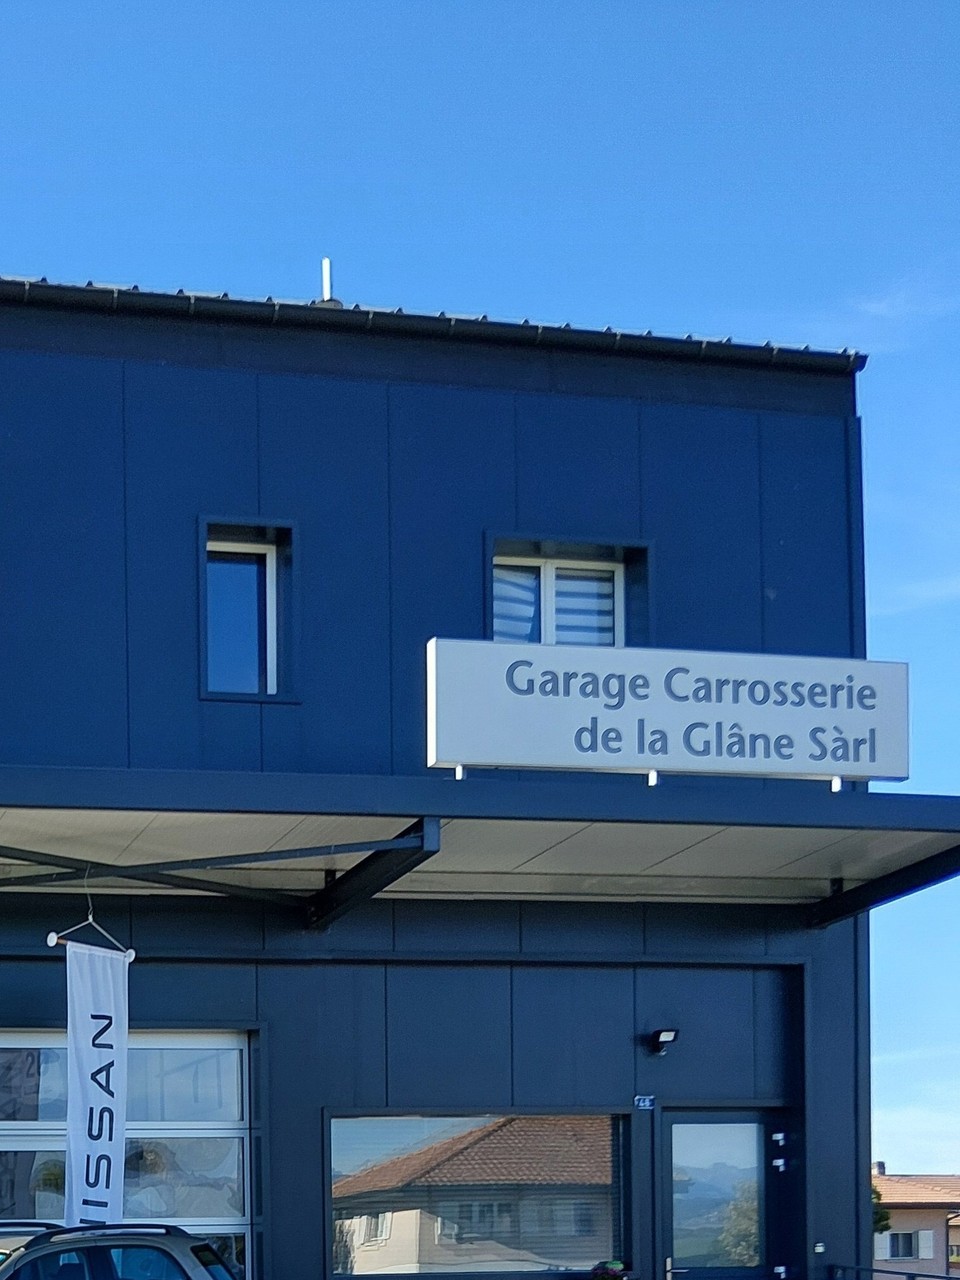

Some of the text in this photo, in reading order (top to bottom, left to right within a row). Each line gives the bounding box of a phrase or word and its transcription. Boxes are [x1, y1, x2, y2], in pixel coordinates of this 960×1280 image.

[505, 660, 876, 711] Garage Carrosserie
[574, 717, 876, 763] de la Glâne Sàrl
[79, 1013, 115, 1225] ISSAN
